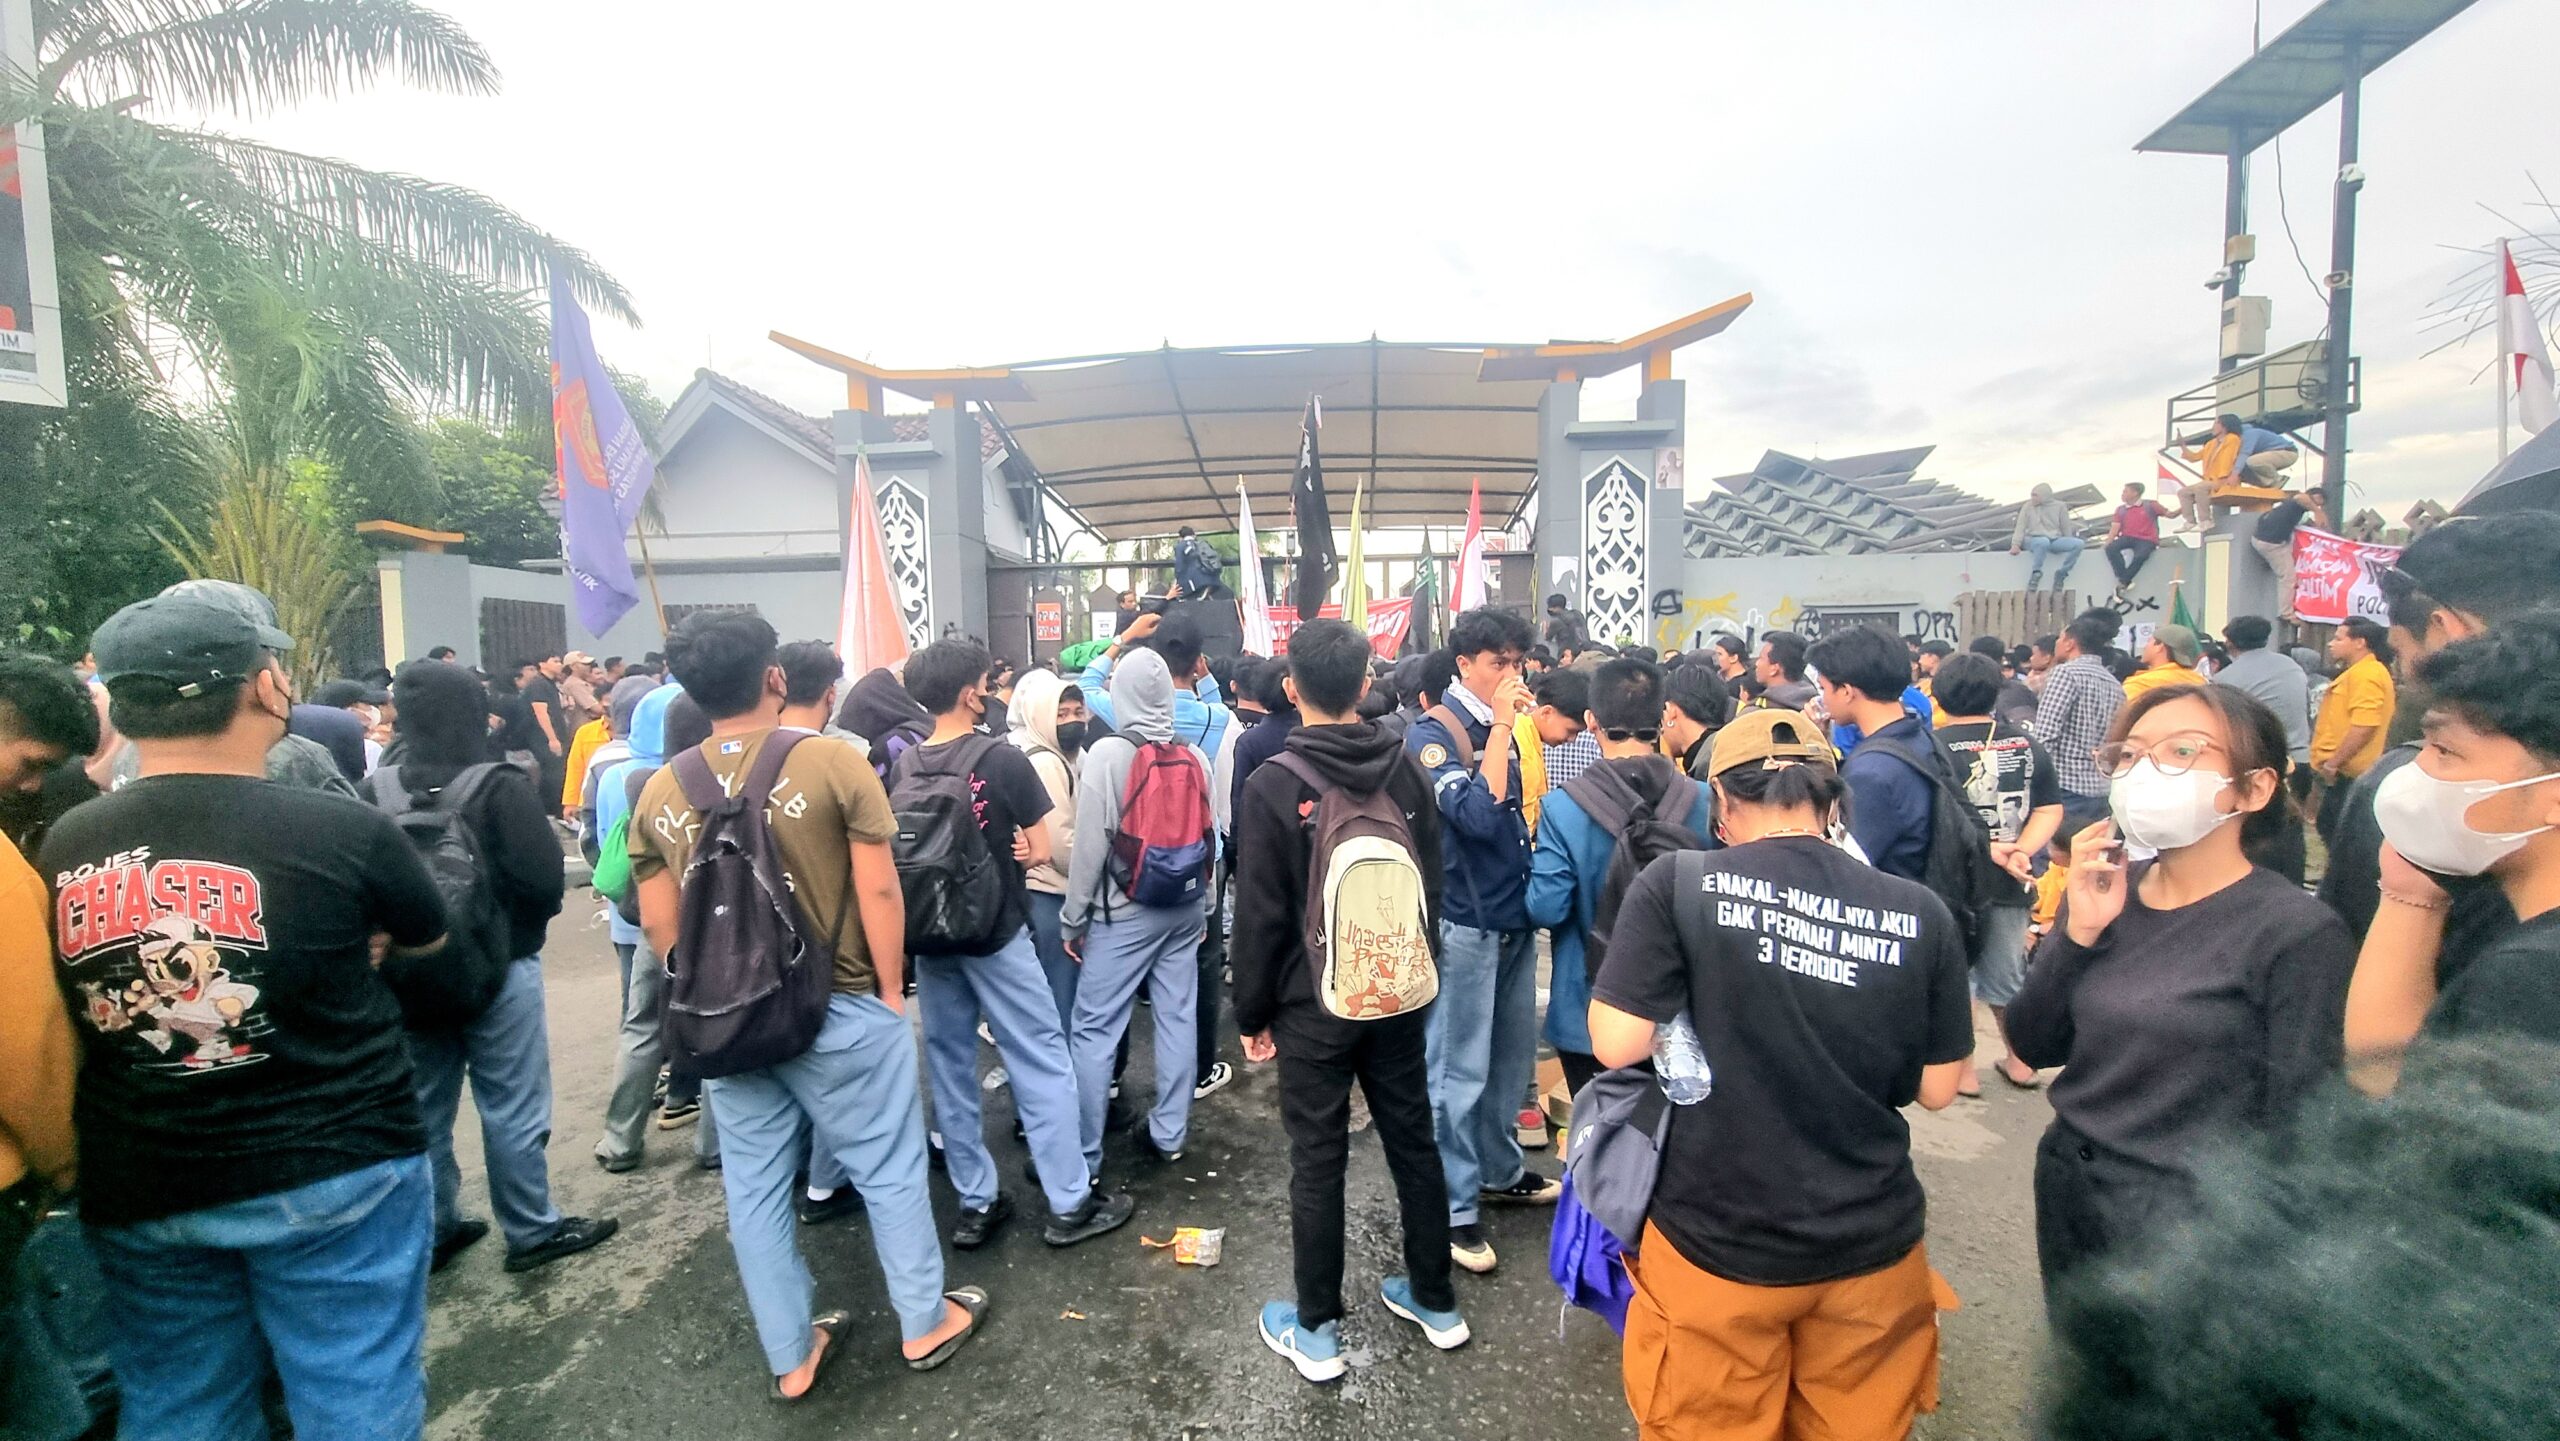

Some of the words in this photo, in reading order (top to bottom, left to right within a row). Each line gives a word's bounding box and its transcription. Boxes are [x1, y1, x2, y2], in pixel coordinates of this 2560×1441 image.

[1913, 610, 1958, 642] DPR
[2357, 595, 2385, 615] POL
[57, 859, 269, 967] CHASER
[1702, 871, 1876, 930] ENAKAL-NAKALNYA
[1880, 909, 1918, 939] AKU
[1717, 900, 1756, 930] GAK
[1762, 908, 1834, 952] PERNAH
[1839, 932, 1901, 967] MINTA
[1758, 936, 1774, 964] 3
